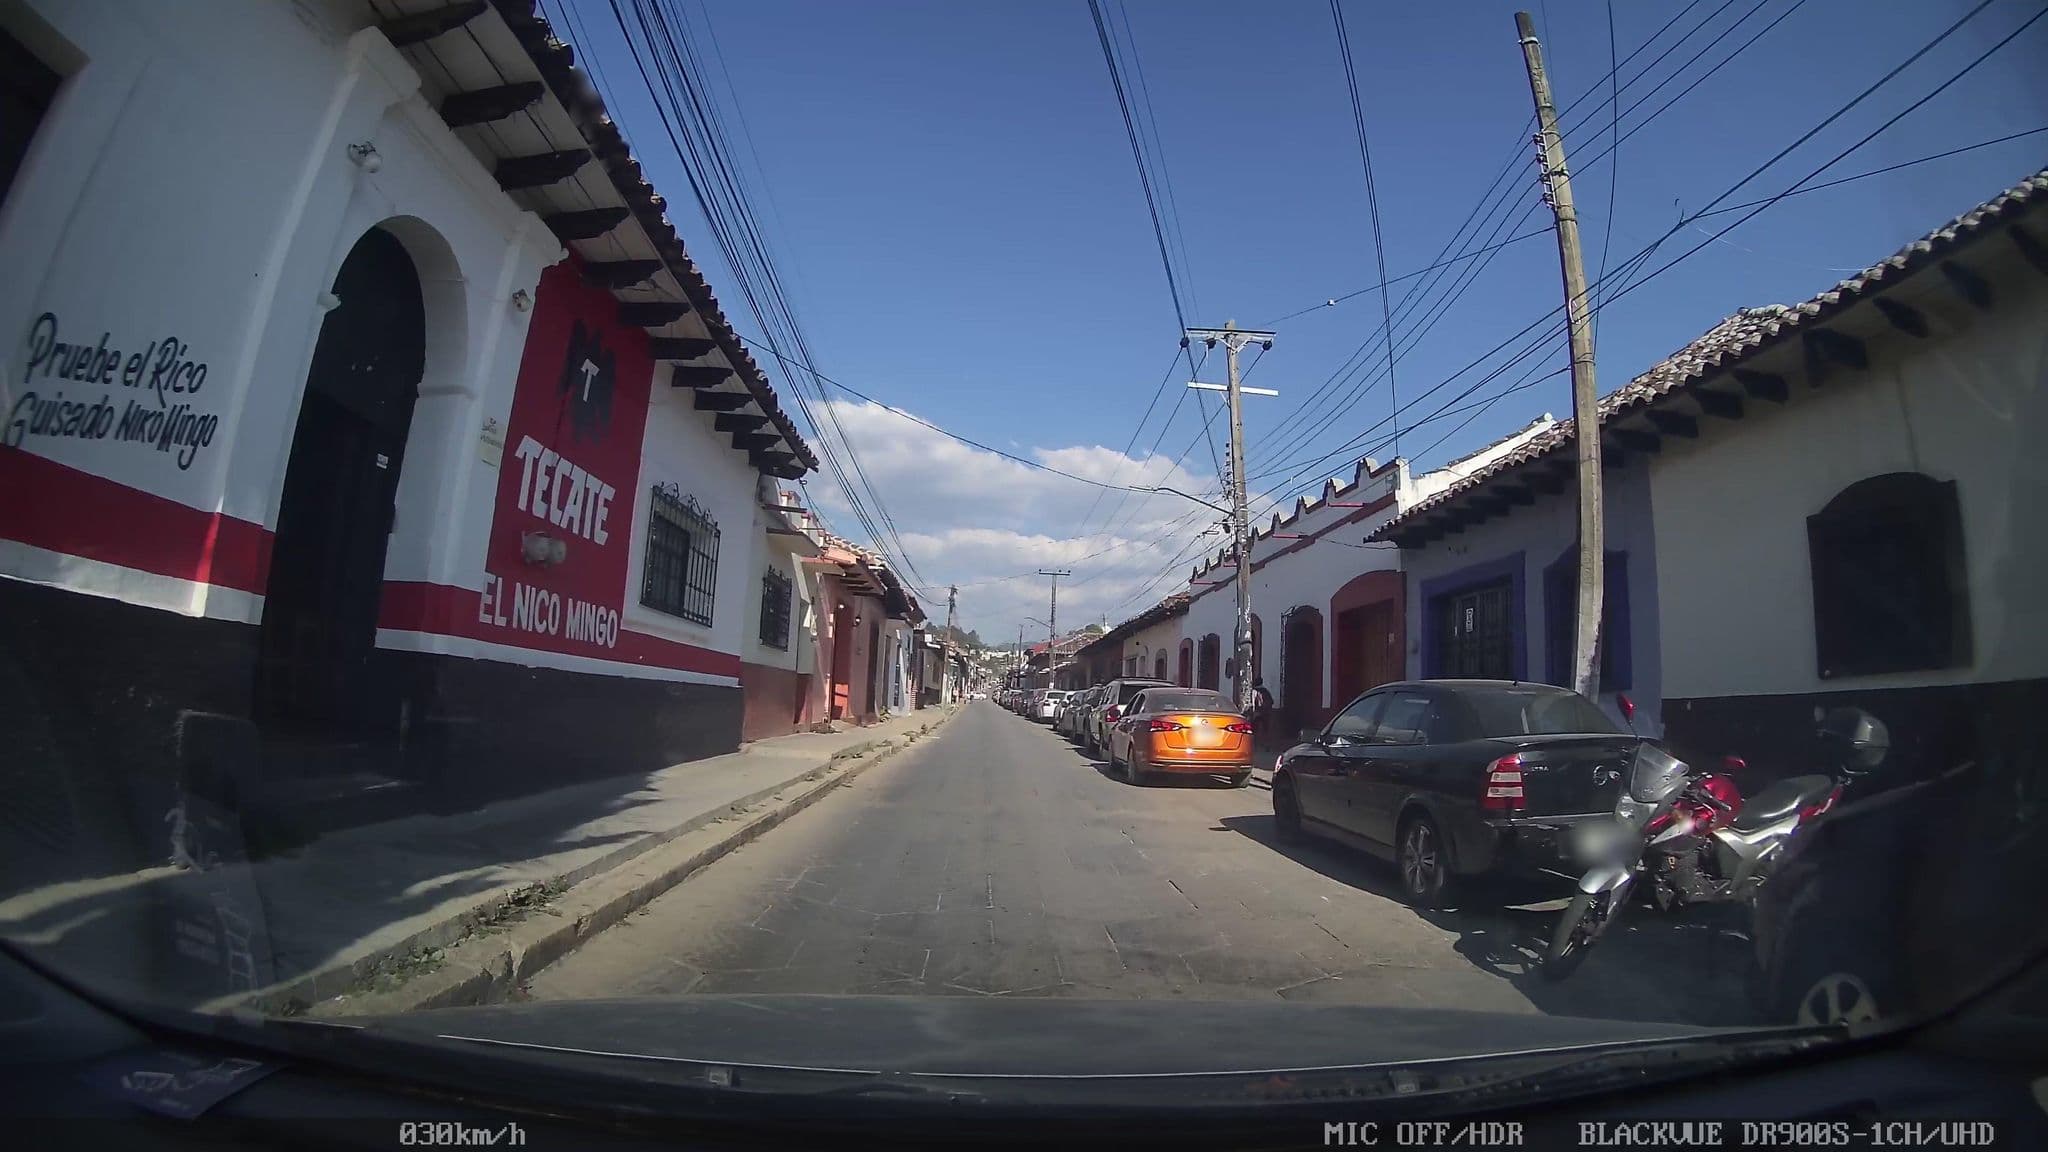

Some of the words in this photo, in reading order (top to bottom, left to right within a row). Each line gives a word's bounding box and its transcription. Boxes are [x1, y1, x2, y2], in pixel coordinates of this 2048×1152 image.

[25, 312, 121, 384] Pruebe
[123, 341, 156, 387] el
[149, 336, 207, 409] Rico
[581, 358, 600, 402] T
[3, 391, 115, 448] Guisado
[515, 434, 616, 546] TECATE
[479, 571, 507, 627] EL
[512, 582, 560, 636] NICO
[565, 598, 618, 649] MINGO
